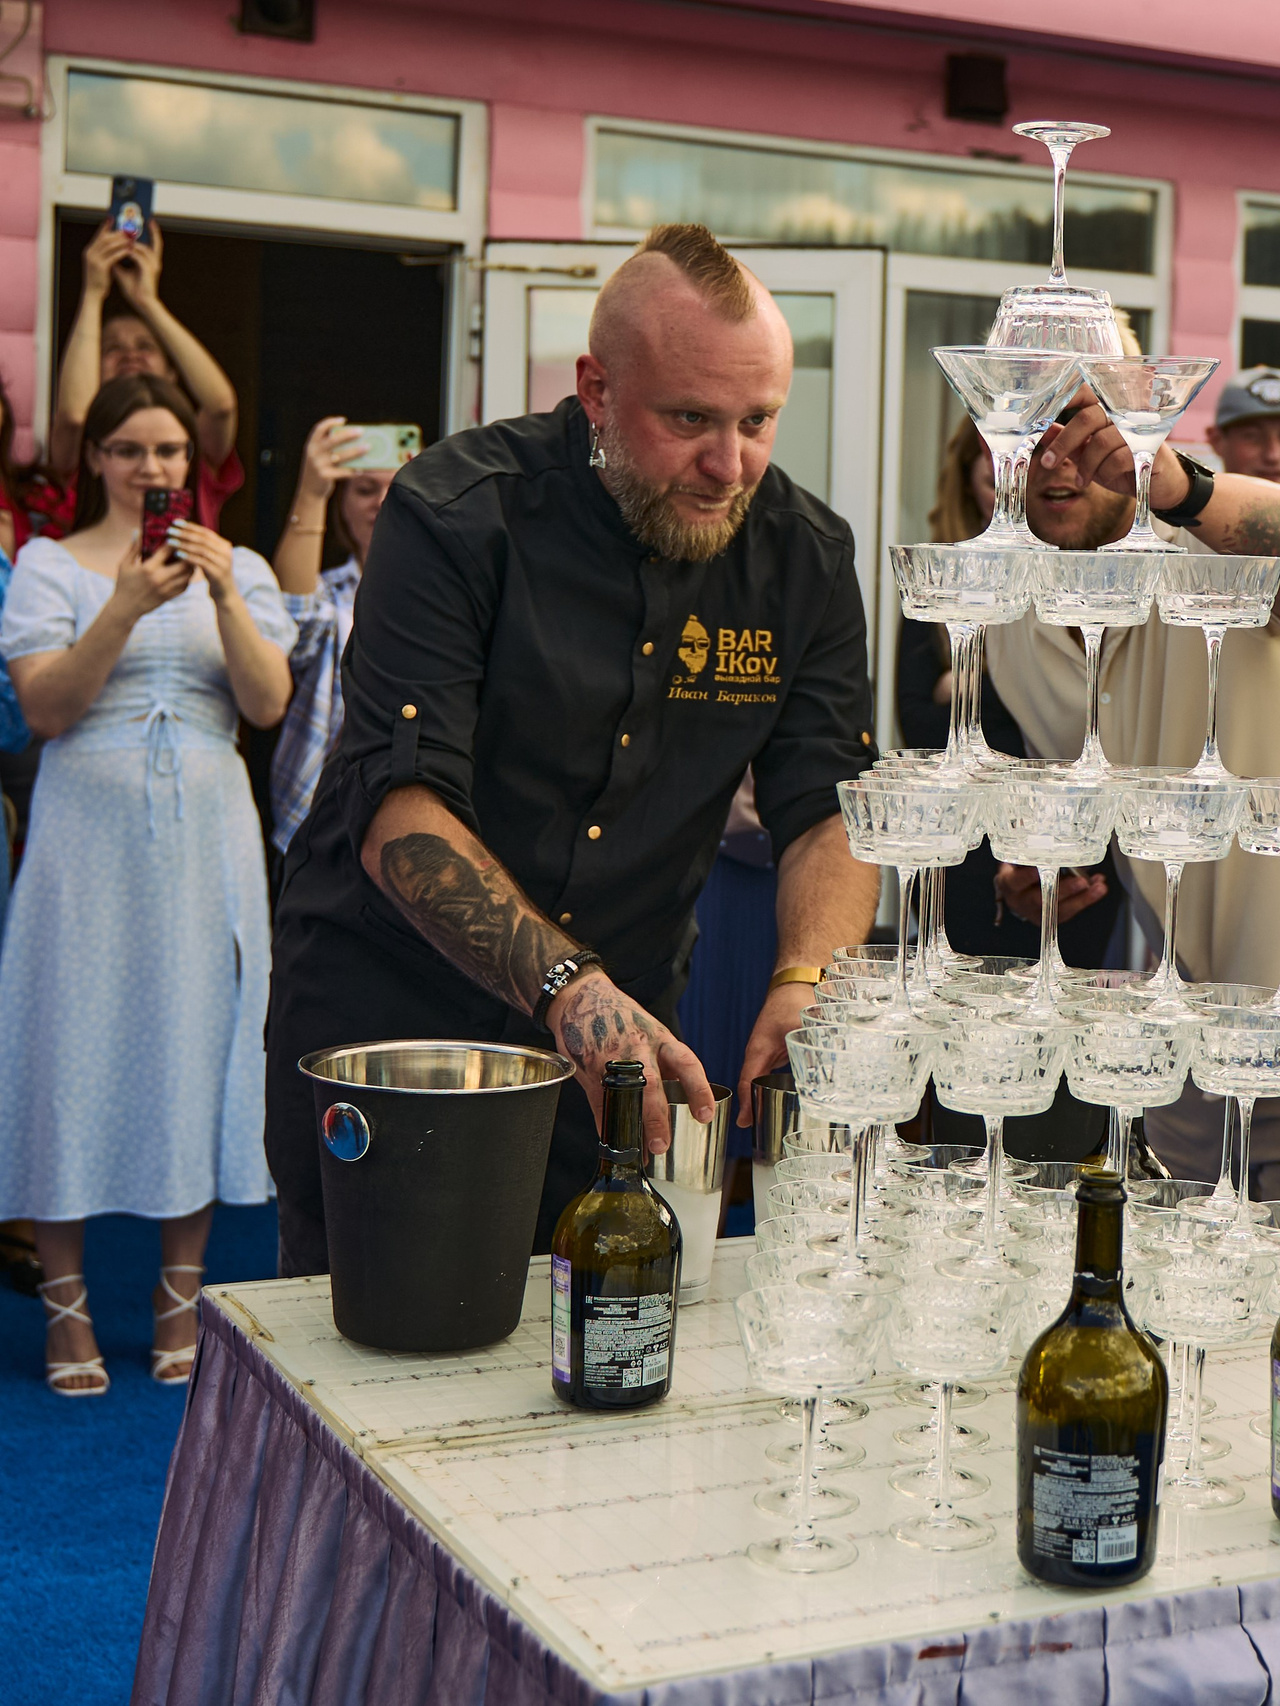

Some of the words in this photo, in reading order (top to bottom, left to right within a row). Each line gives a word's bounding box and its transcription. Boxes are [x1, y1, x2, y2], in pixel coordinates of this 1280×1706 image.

[718, 628, 773, 652] BAR
[763, 675, 781, 685] бар
[667, 687, 708, 700] Иван
[716, 690, 777, 705] Бариков
[1121, 1513, 1136, 1522] AST
